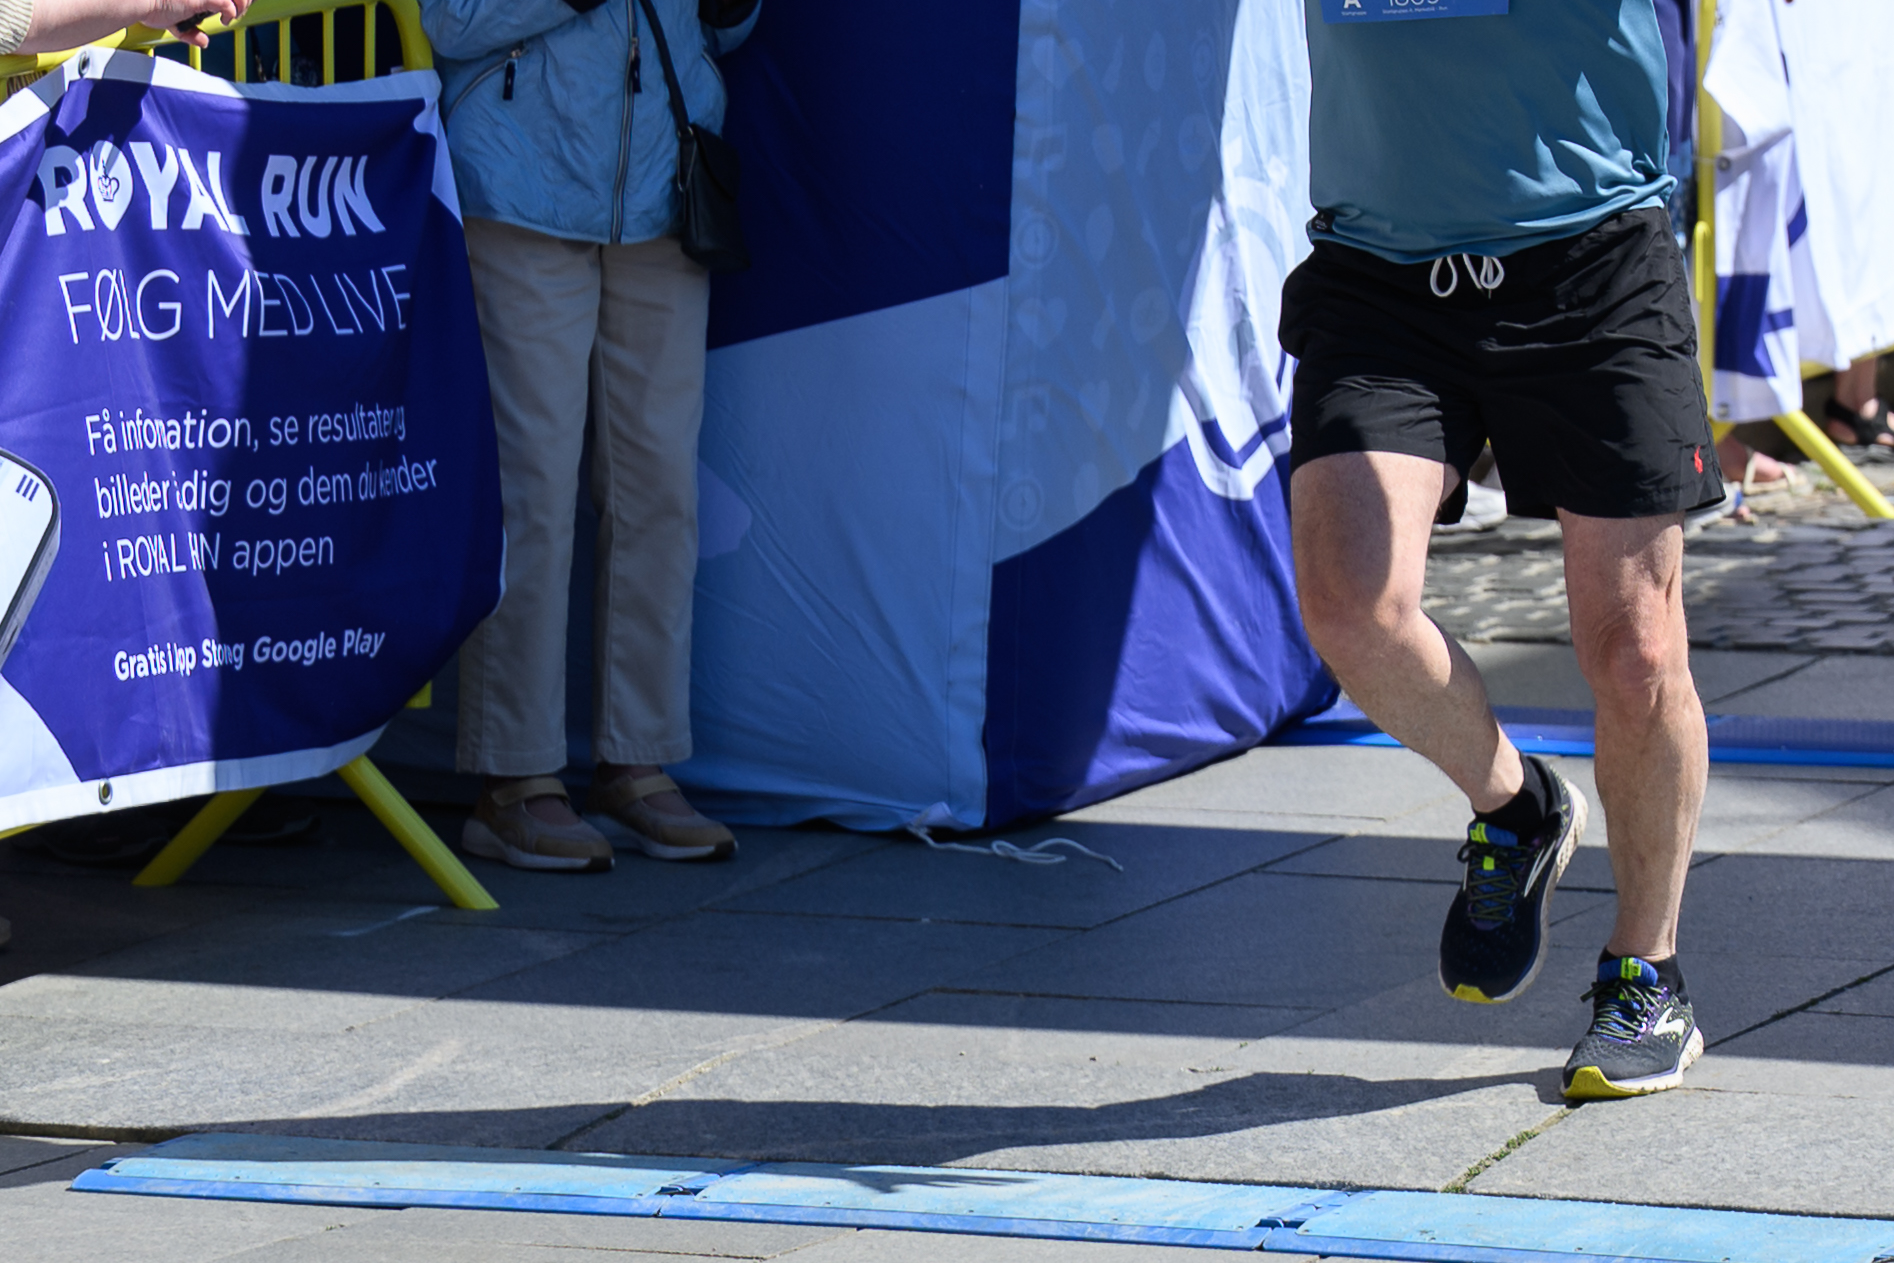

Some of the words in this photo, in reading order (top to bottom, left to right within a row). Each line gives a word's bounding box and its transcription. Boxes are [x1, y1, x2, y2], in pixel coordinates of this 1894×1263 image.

[37, 140, 251, 237] ROYAL
[262, 155, 386, 237] RUN
[58, 269, 183, 345] FØLG
[207, 269, 313, 339] MED
[310, 264, 411, 335] LIVE
[85, 408, 117, 456] Få
[269, 415, 299, 446] se
[94, 470, 170, 519] billeder
[181, 469, 232, 517] dig
[246, 478, 288, 515] og
[298, 465, 353, 506] dem
[358, 461, 377, 501] du
[379, 454, 438, 498] kender
[103, 541, 112, 583] i
[116, 532, 188, 579] ROYAL
[232, 536, 334, 577] appen
[114, 644, 167, 682] Gratis
[166, 642, 174, 673] i
[253, 635, 337, 667] Google
[342, 627, 386, 658] Play
